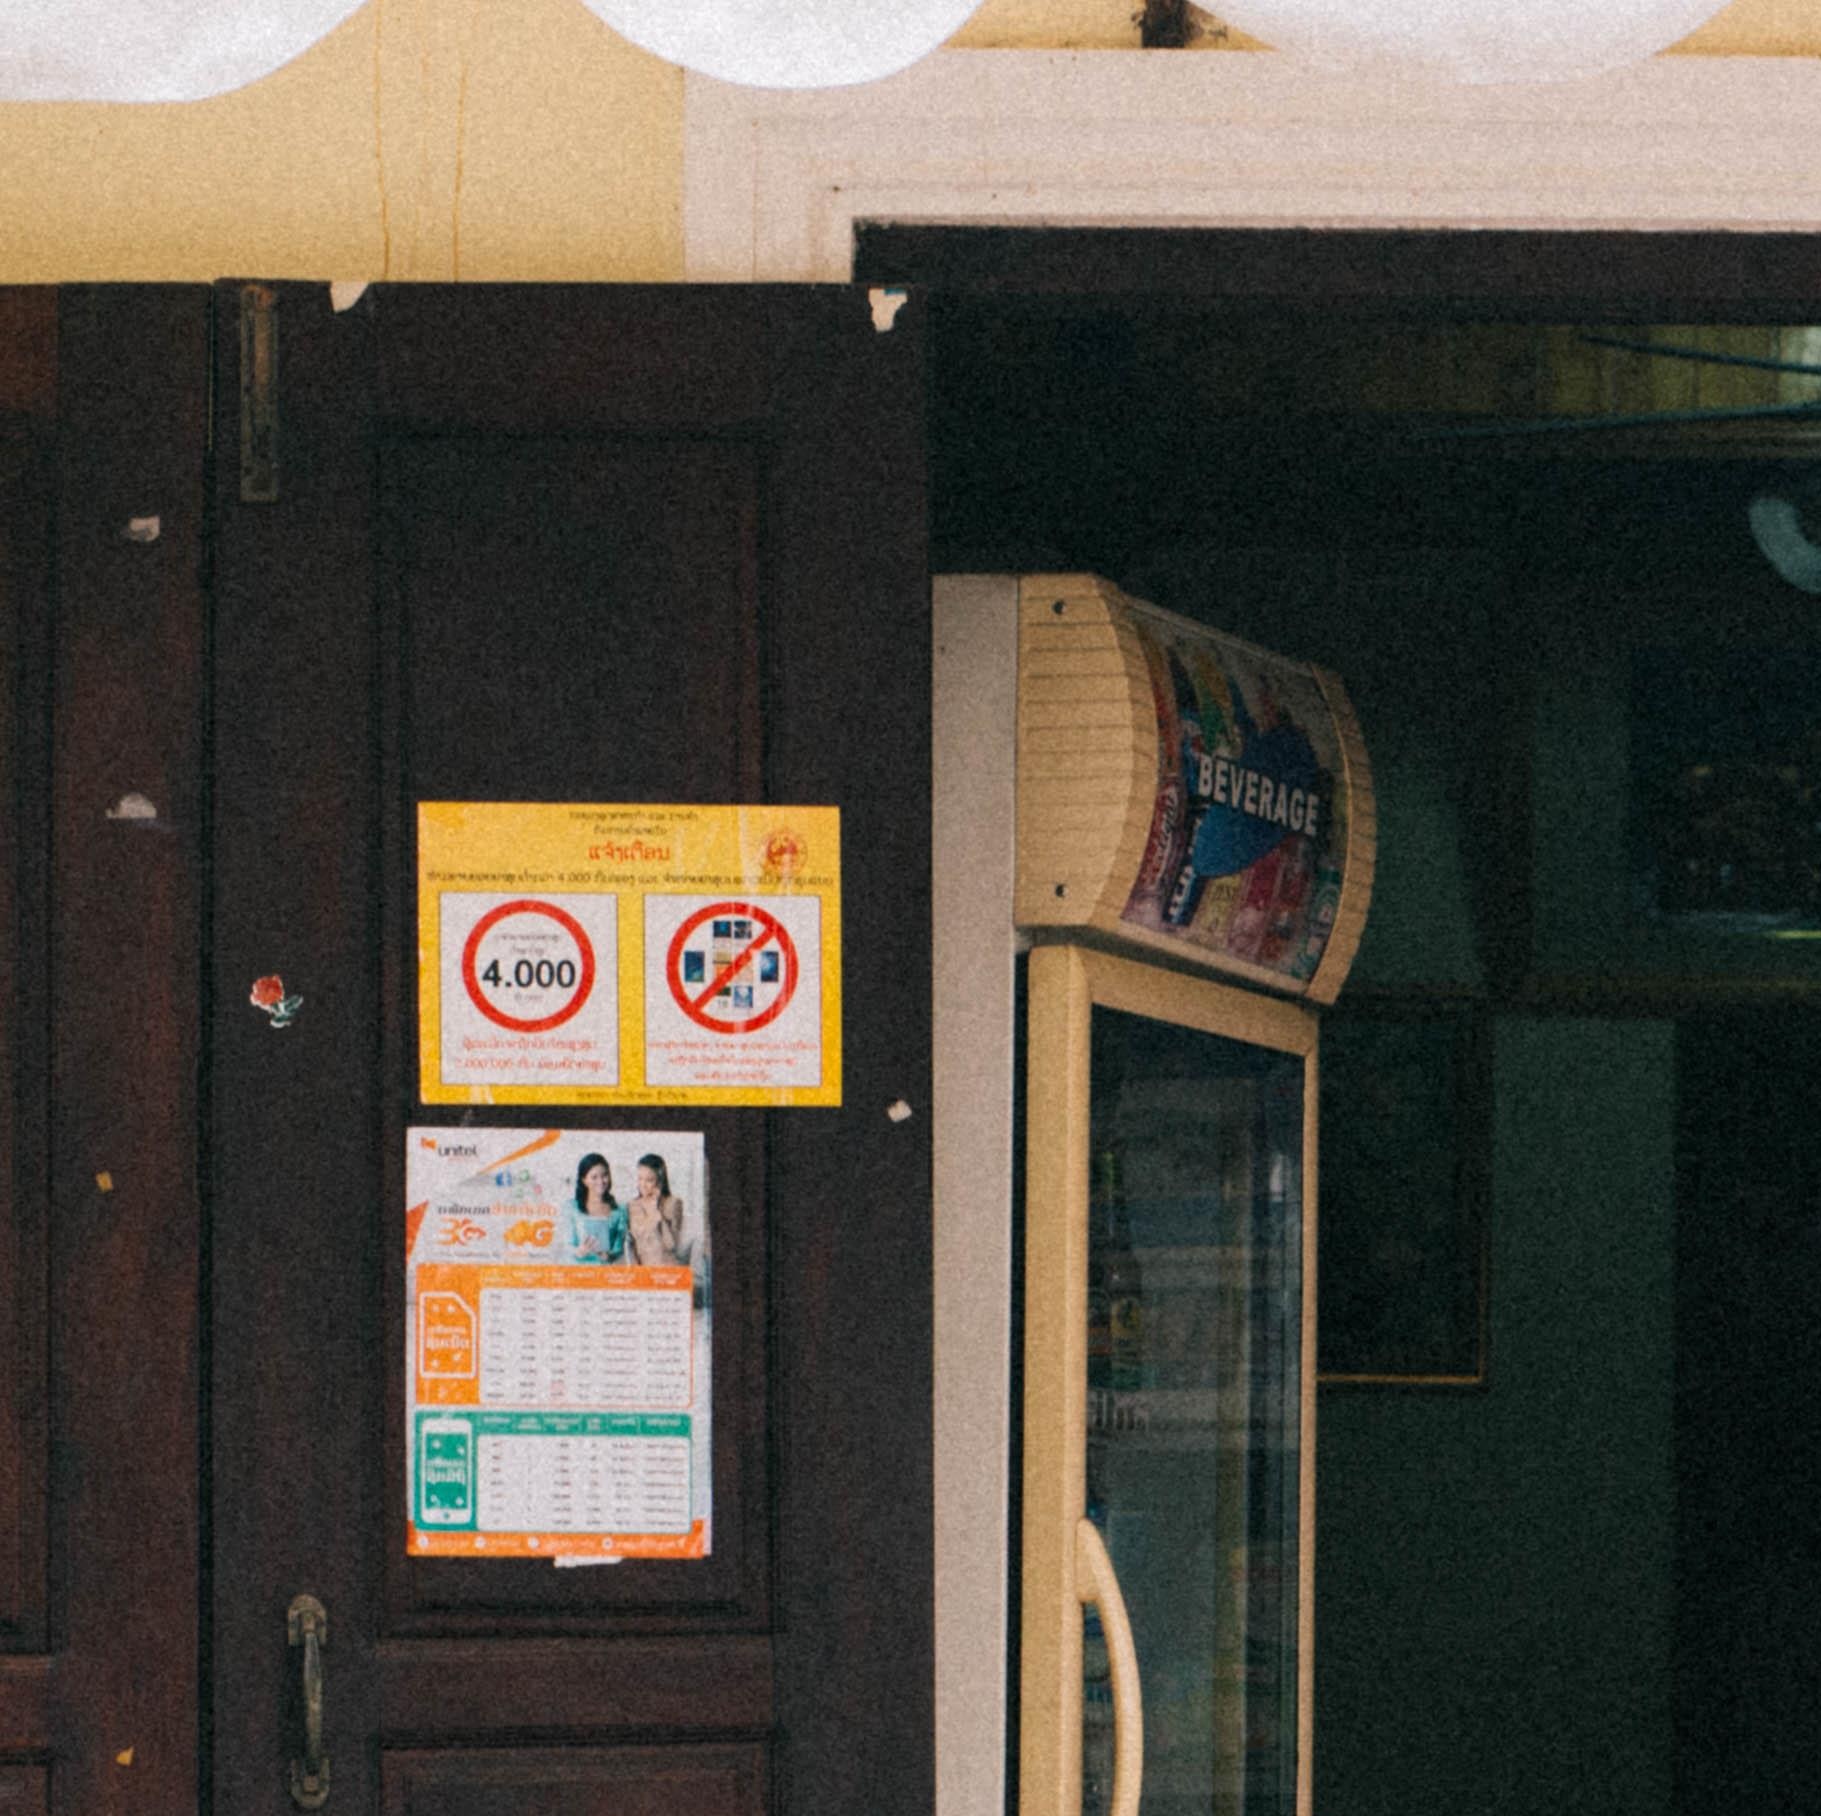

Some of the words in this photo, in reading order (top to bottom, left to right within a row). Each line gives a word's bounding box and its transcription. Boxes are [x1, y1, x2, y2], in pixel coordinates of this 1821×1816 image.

[1198, 753, 1321, 837] BEVERAGE
[482, 959, 576, 988] 4.000
[438, 1145, 478, 1158] unitel
